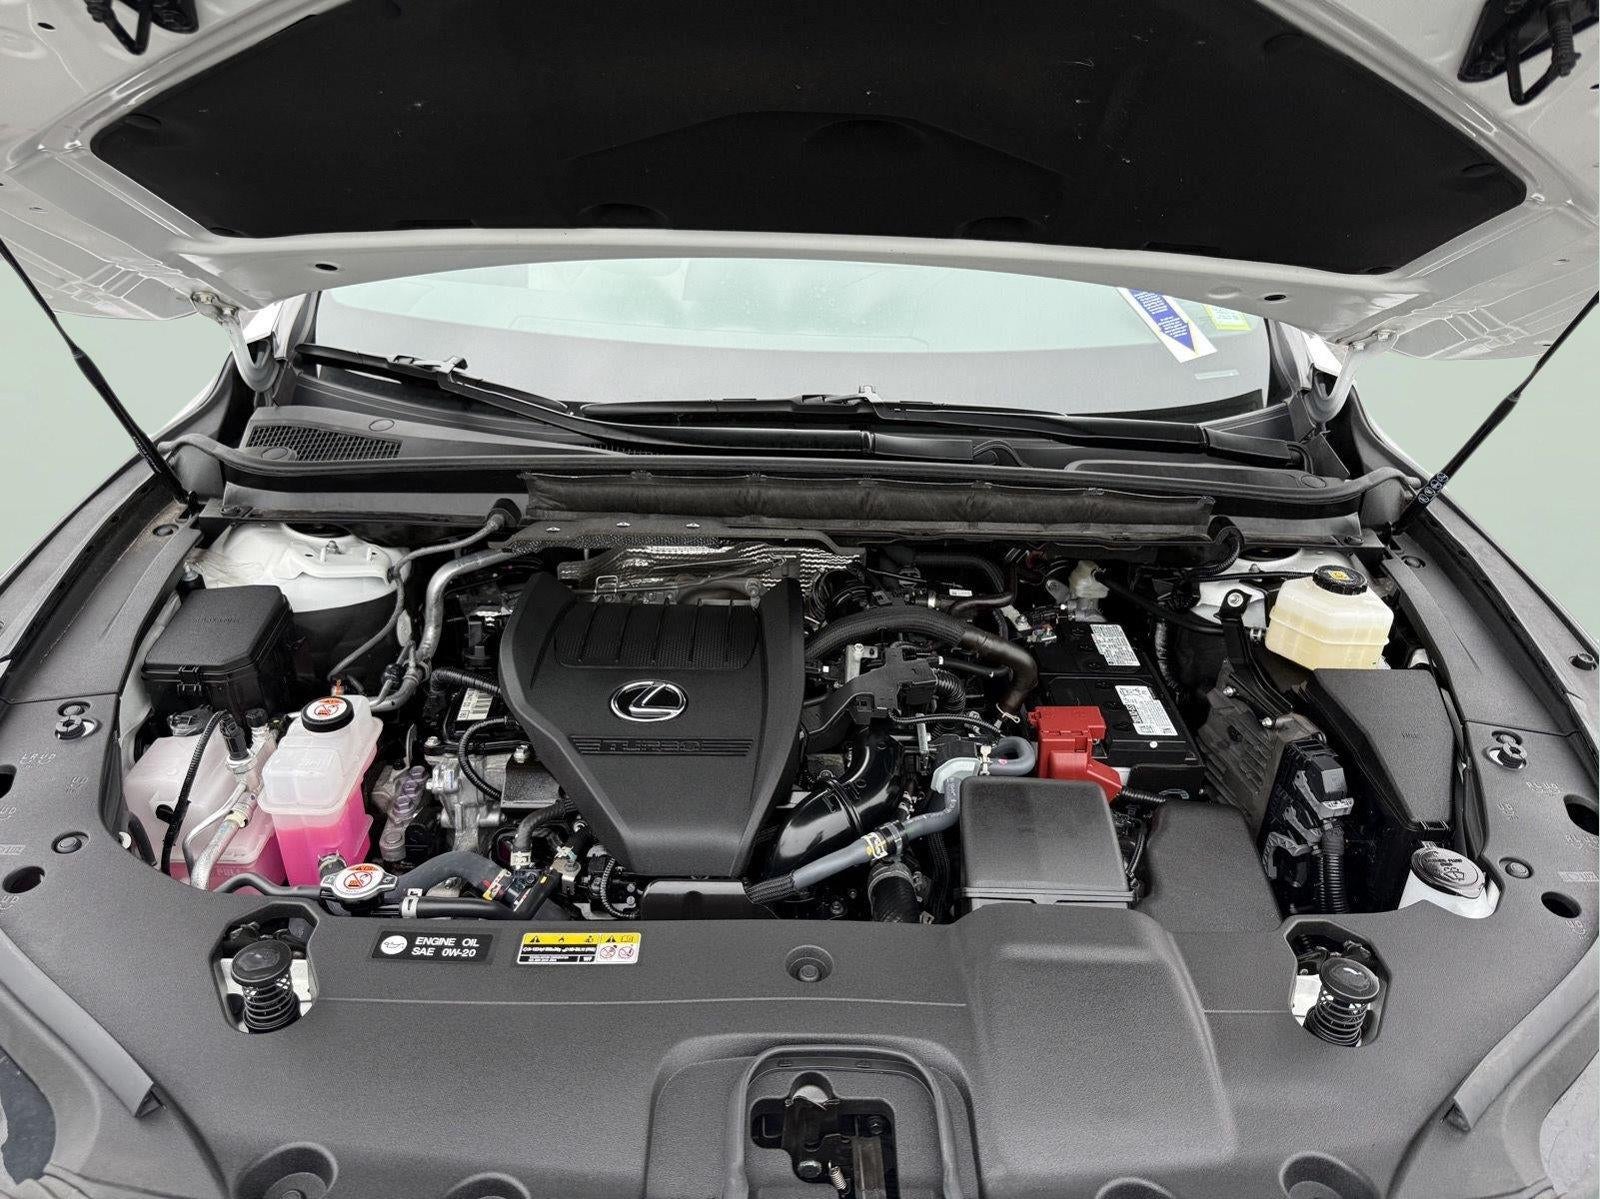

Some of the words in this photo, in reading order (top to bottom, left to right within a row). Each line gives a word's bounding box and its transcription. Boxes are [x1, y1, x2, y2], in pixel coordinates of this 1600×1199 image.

[601, 740, 700, 753] TURBO
[415, 936, 457, 946] ENGINE
[461, 938, 480, 947] OIL
[411, 946, 436, 956] SAE
[441, 947, 477, 957] 0W-20
